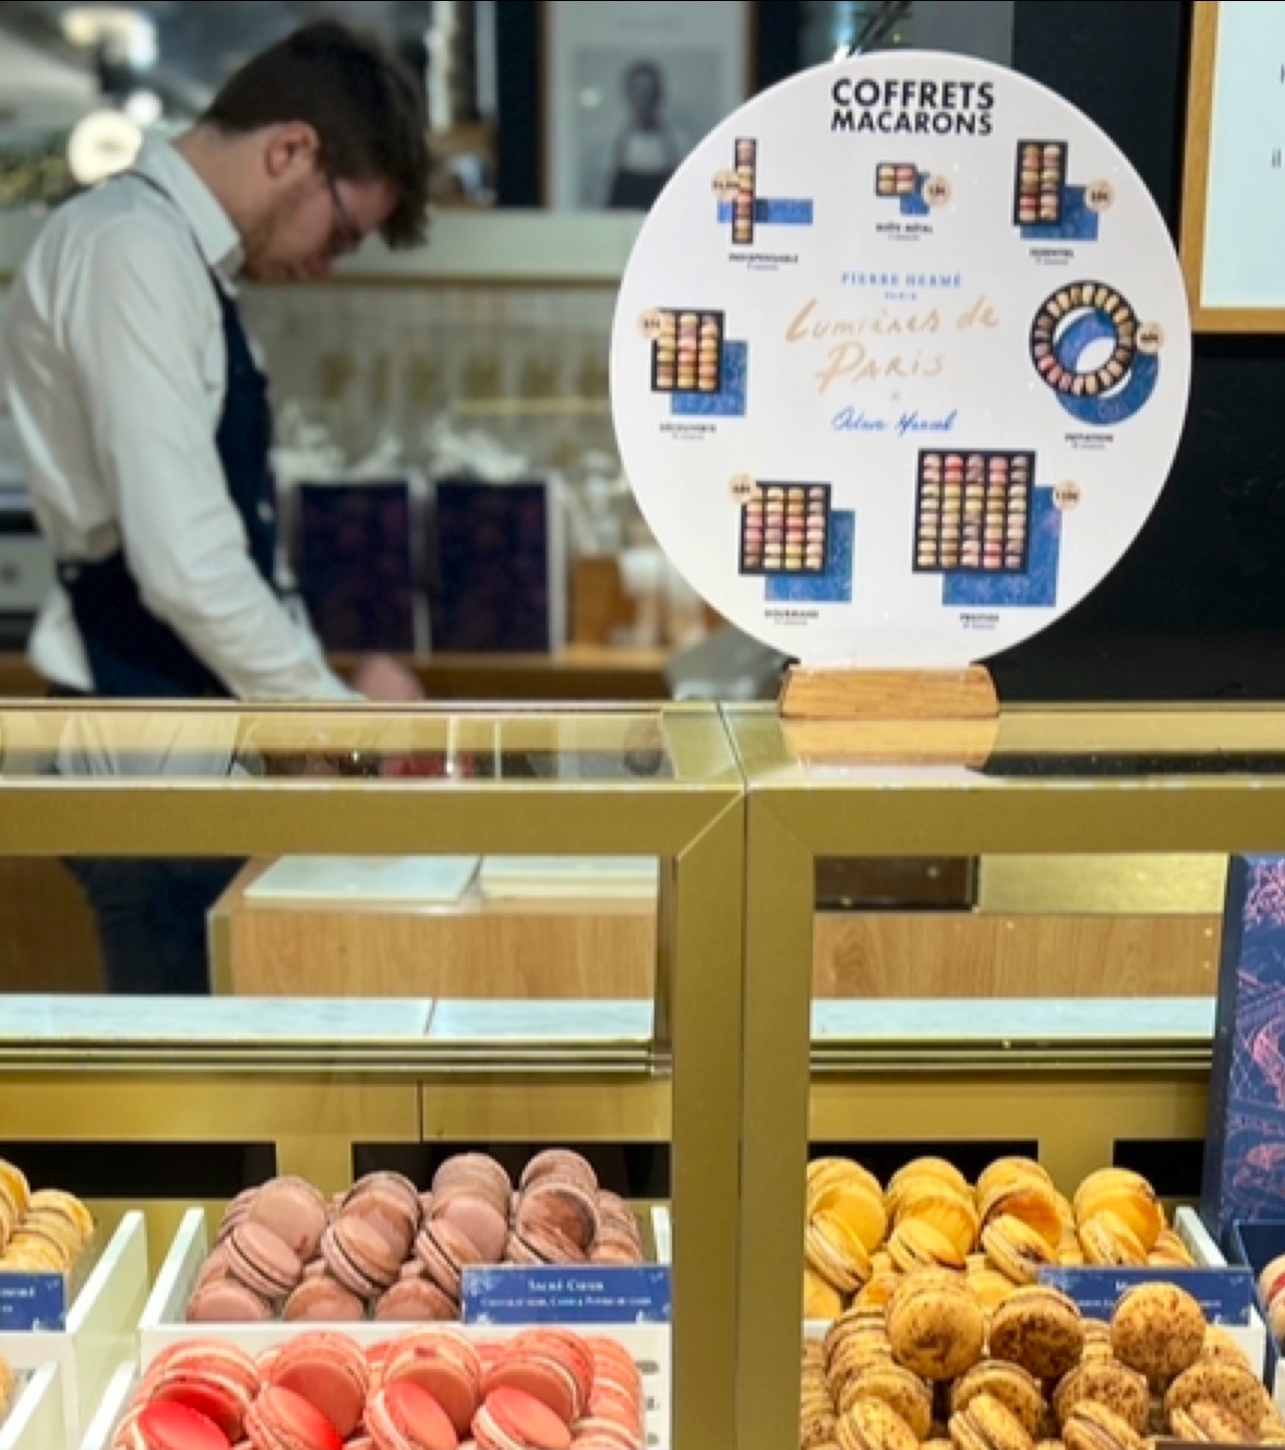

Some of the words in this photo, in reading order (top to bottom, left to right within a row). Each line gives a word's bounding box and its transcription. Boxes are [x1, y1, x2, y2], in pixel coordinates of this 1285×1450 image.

[831, 78, 994, 110] COFFRETS
[830, 111, 994, 136] MACARONS
[841, 272, 899, 287] PIERRE
[905, 272, 962, 287] HERMÉ
